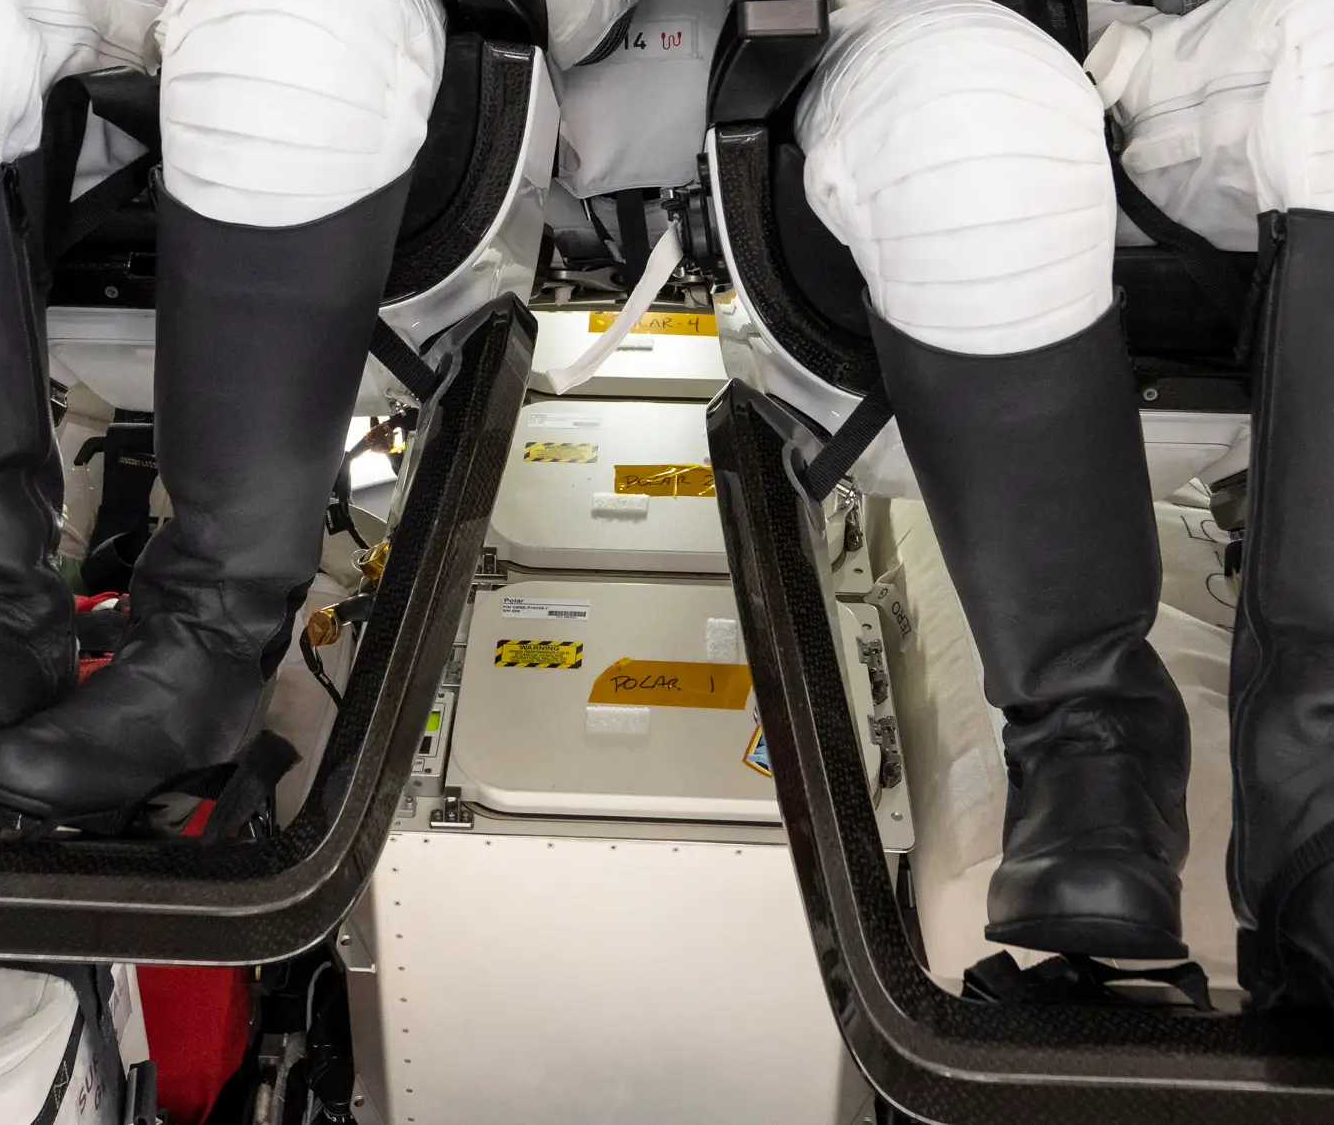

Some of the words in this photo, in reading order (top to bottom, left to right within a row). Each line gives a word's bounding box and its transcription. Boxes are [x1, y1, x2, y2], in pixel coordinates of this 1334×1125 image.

[877, 588, 888, 599] G
[891, 601, 912, 639] ZERO
[519, 644, 560, 652] WARNING
[611, 675, 681, 693] POLAR
[709, 676, 715, 693] 1
